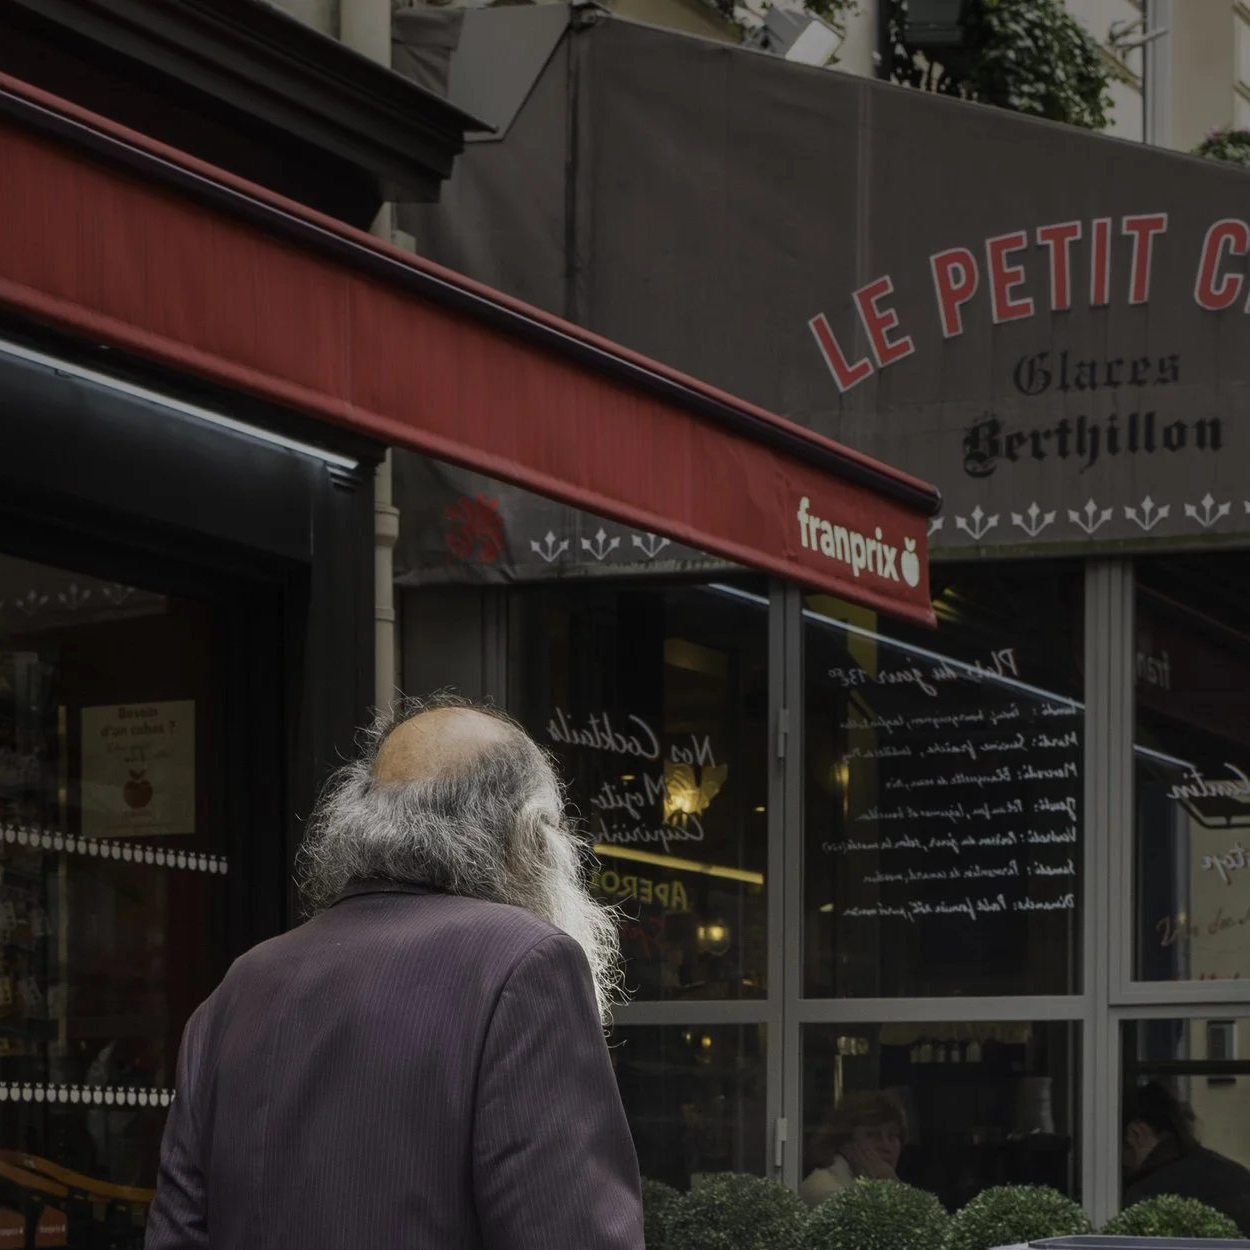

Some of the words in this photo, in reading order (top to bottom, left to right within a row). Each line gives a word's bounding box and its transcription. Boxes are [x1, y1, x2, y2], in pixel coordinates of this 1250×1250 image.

[807, 274, 916, 394] LE
[929, 213, 1168, 339] PETIT
[1193, 218, 1250, 314] C
[1013, 350, 1181, 396] Glaces
[962, 409, 1225, 478] Berthillon
[797, 496, 900, 582] franprix
